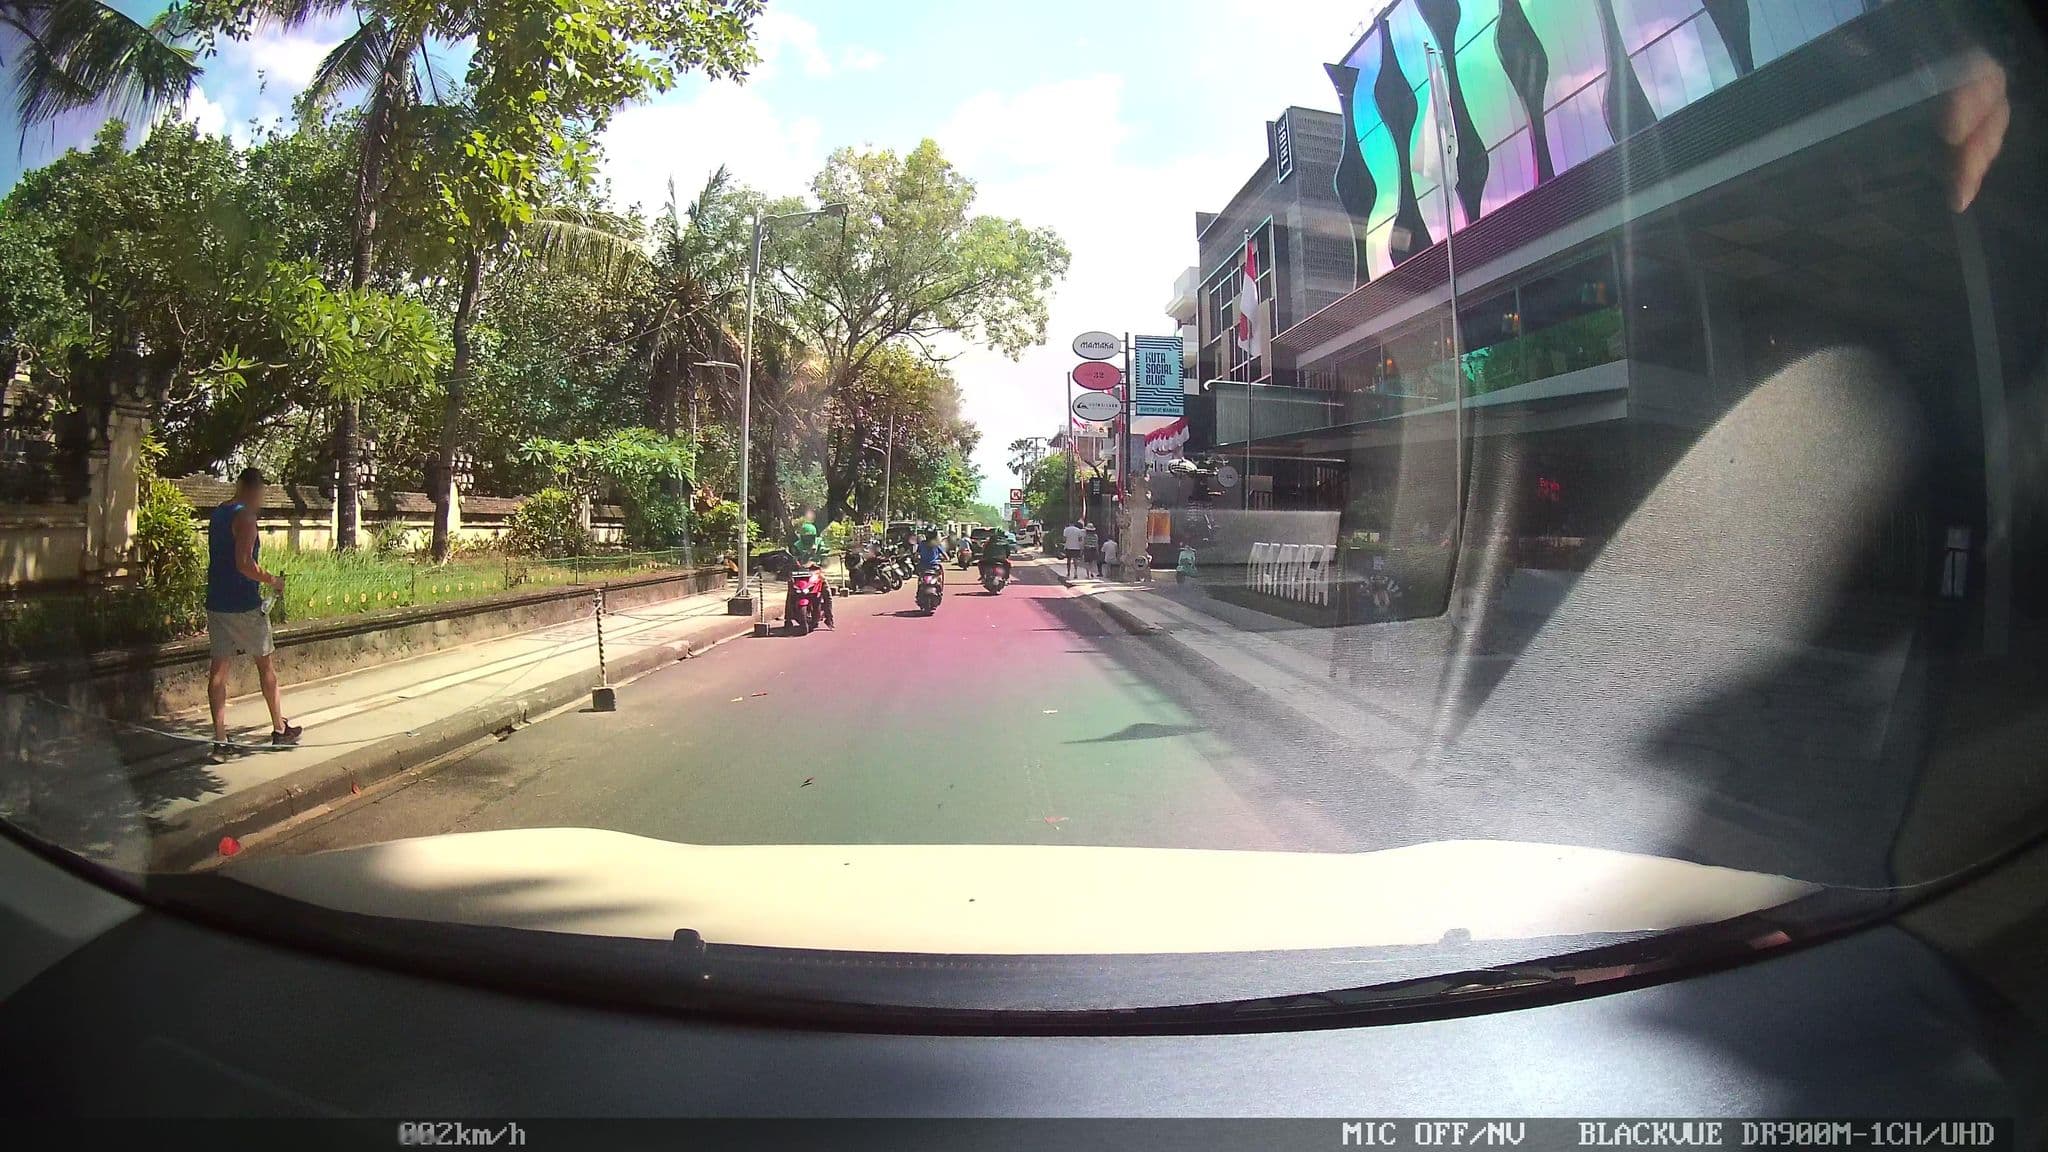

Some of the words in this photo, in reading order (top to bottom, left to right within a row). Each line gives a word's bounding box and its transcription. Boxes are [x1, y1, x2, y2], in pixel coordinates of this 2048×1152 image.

[1277, 120, 1288, 170] TRIBE
[1080, 342, 1114, 351] MAMAKA
[1145, 352, 1166, 364] KUTA
[1145, 363, 1173, 375] SOCIAL
[1145, 374, 1166, 386] CLUB
